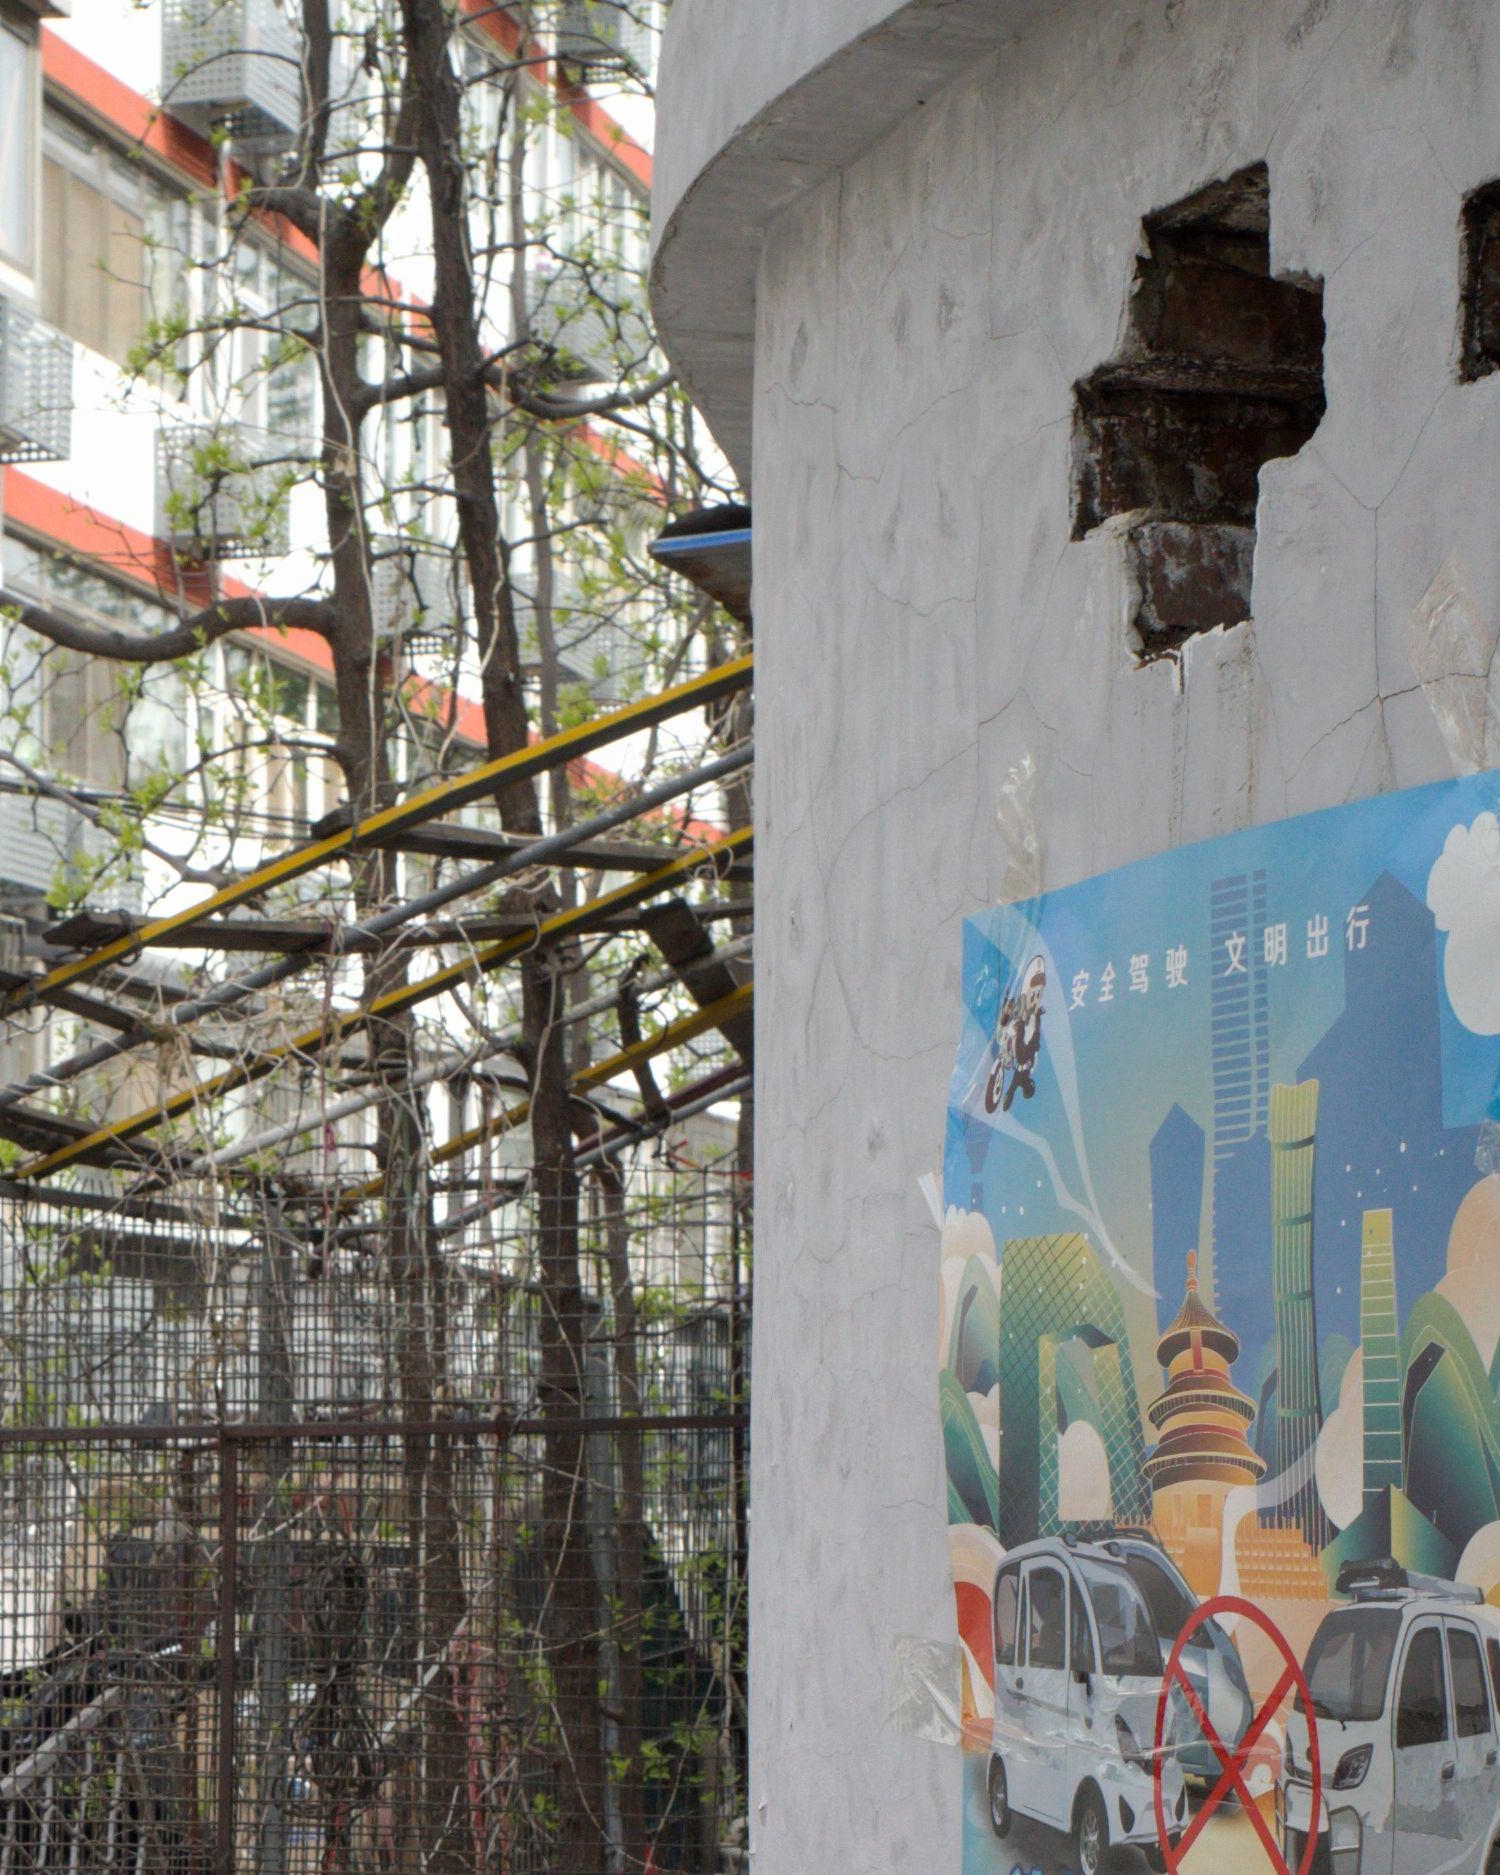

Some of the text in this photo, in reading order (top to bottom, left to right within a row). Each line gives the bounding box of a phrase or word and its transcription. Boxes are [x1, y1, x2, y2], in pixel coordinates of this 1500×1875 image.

[1069, 904, 1369, 1011] 安全驾驶 文明出行
